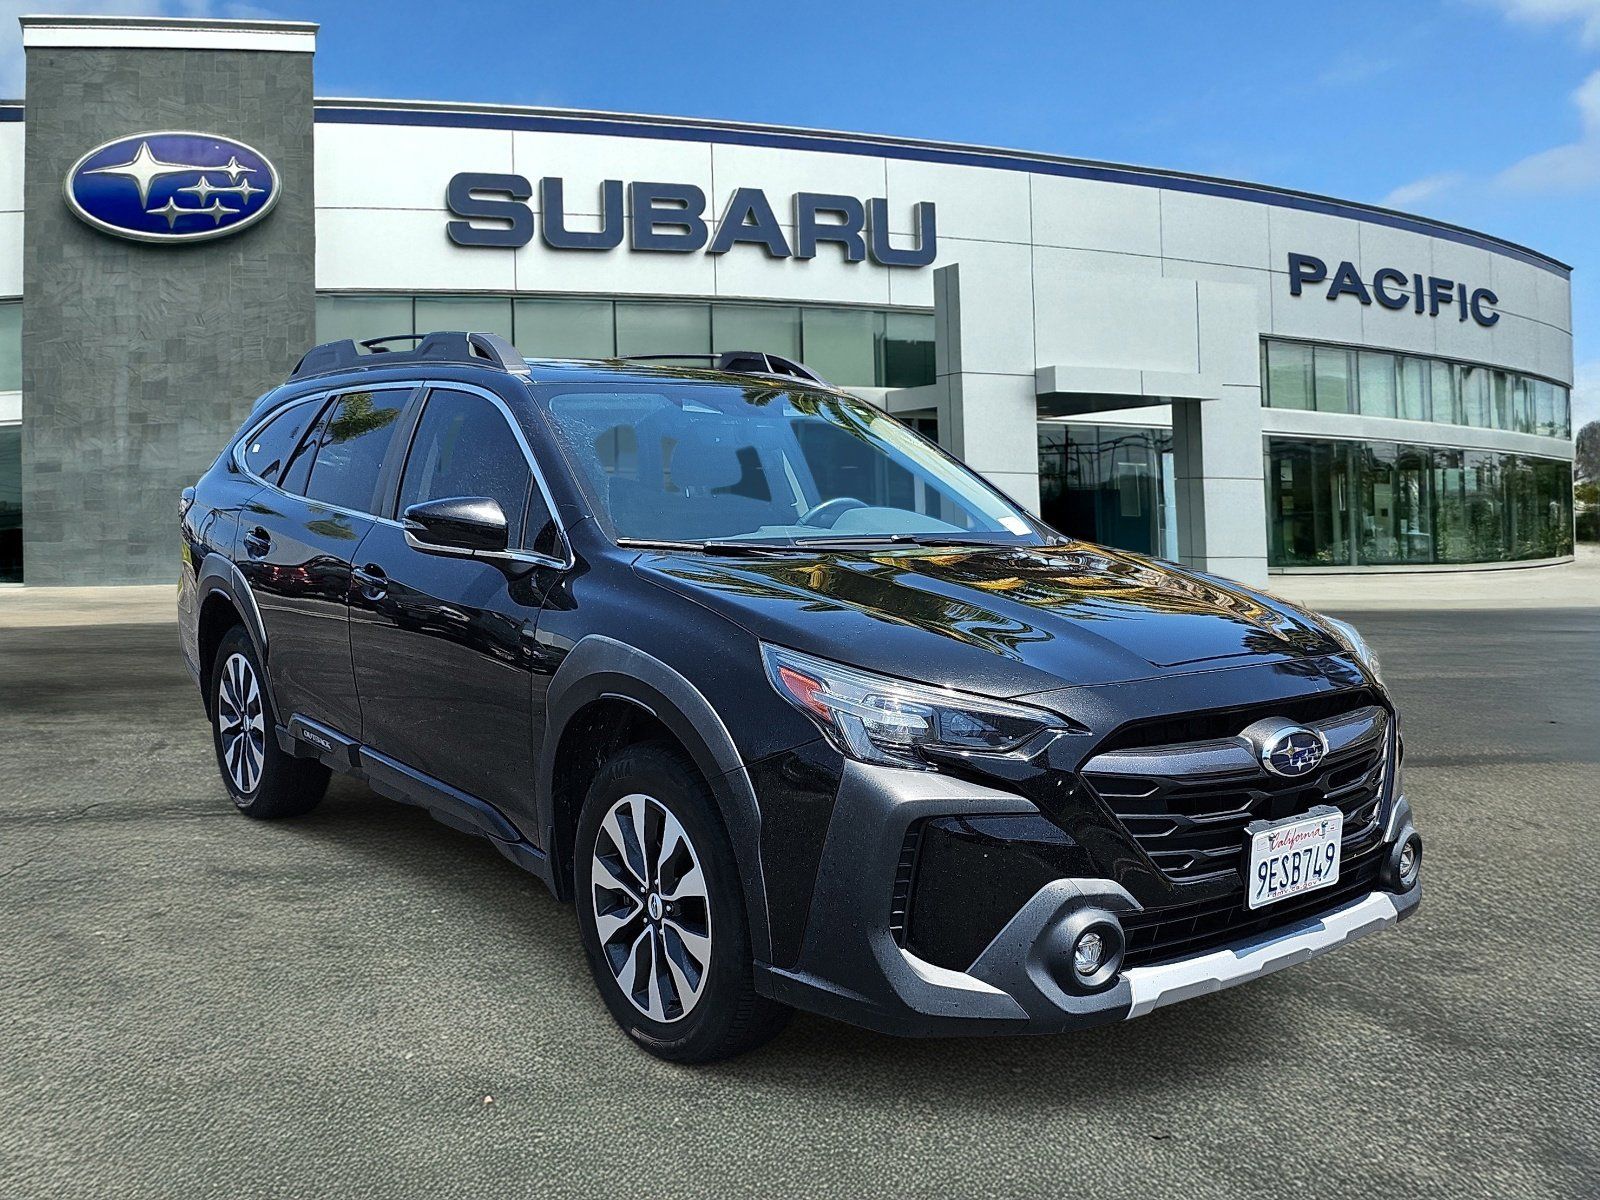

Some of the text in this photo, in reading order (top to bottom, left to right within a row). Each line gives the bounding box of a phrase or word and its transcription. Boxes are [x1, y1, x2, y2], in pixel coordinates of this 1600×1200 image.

[446, 171, 937, 267] SUBARU
[1288, 252, 1500, 327] PACIFIC
[1256, 842, 1335, 900] 9ESB749
[1270, 828, 1320, 852] California
